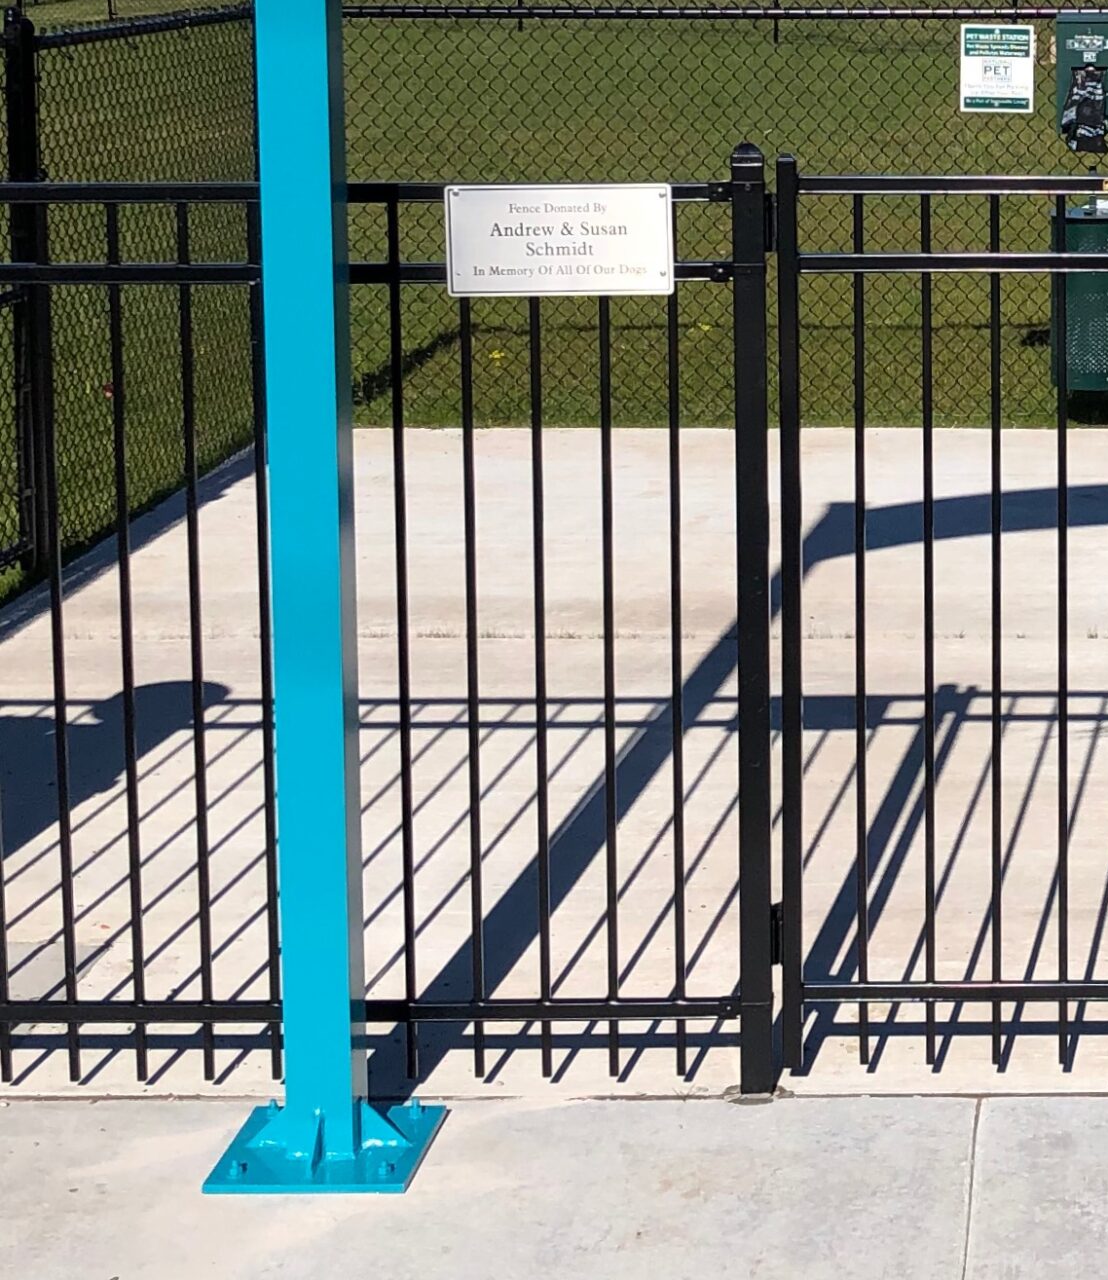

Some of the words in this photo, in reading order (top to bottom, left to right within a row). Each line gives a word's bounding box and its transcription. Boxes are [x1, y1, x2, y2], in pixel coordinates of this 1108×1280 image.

[984, 66, 1010, 75] PET
[509, 203, 541, 214] Fence
[544, 202, 589, 213] Donated
[594, 202, 607, 214] By
[490, 222, 554, 237] Andrew
[560, 222, 574, 236] &
[580, 222, 628, 236] Susan
[526, 241, 594, 256] Schmidt
[473, 266, 485, 276] In
[489, 266, 534, 278] Memory
[538, 265, 554, 276] Of
[556, 265, 572, 276] All
[576, 264, 592, 275] Of
[594, 264, 615, 275] Our
[619, 264, 648, 276] Dogs
